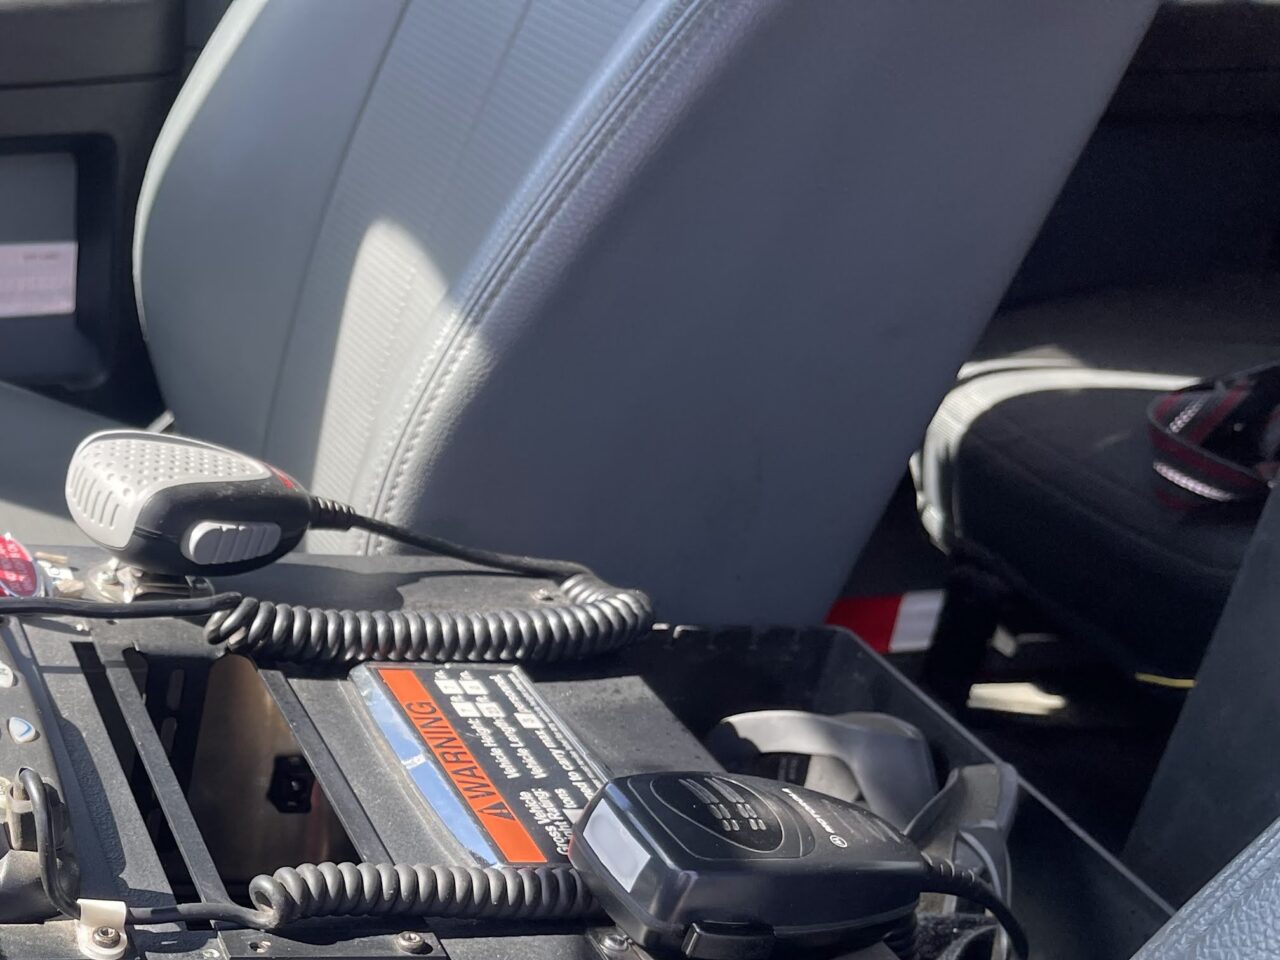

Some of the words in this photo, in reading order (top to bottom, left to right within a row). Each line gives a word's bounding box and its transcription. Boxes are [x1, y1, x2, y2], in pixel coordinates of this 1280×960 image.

[405, 701, 496, 798] WARNING
[490, 747, 521, 778] Vehicle
[517, 747, 547, 779] Vehicle
[549, 749, 577, 771] carry
[568, 771, 583, 780] to
[520, 791, 551, 823] Vehicle
[532, 788, 564, 819] Rating:
[554, 788, 577, 808] tons
[545, 825, 569, 855] Gross
